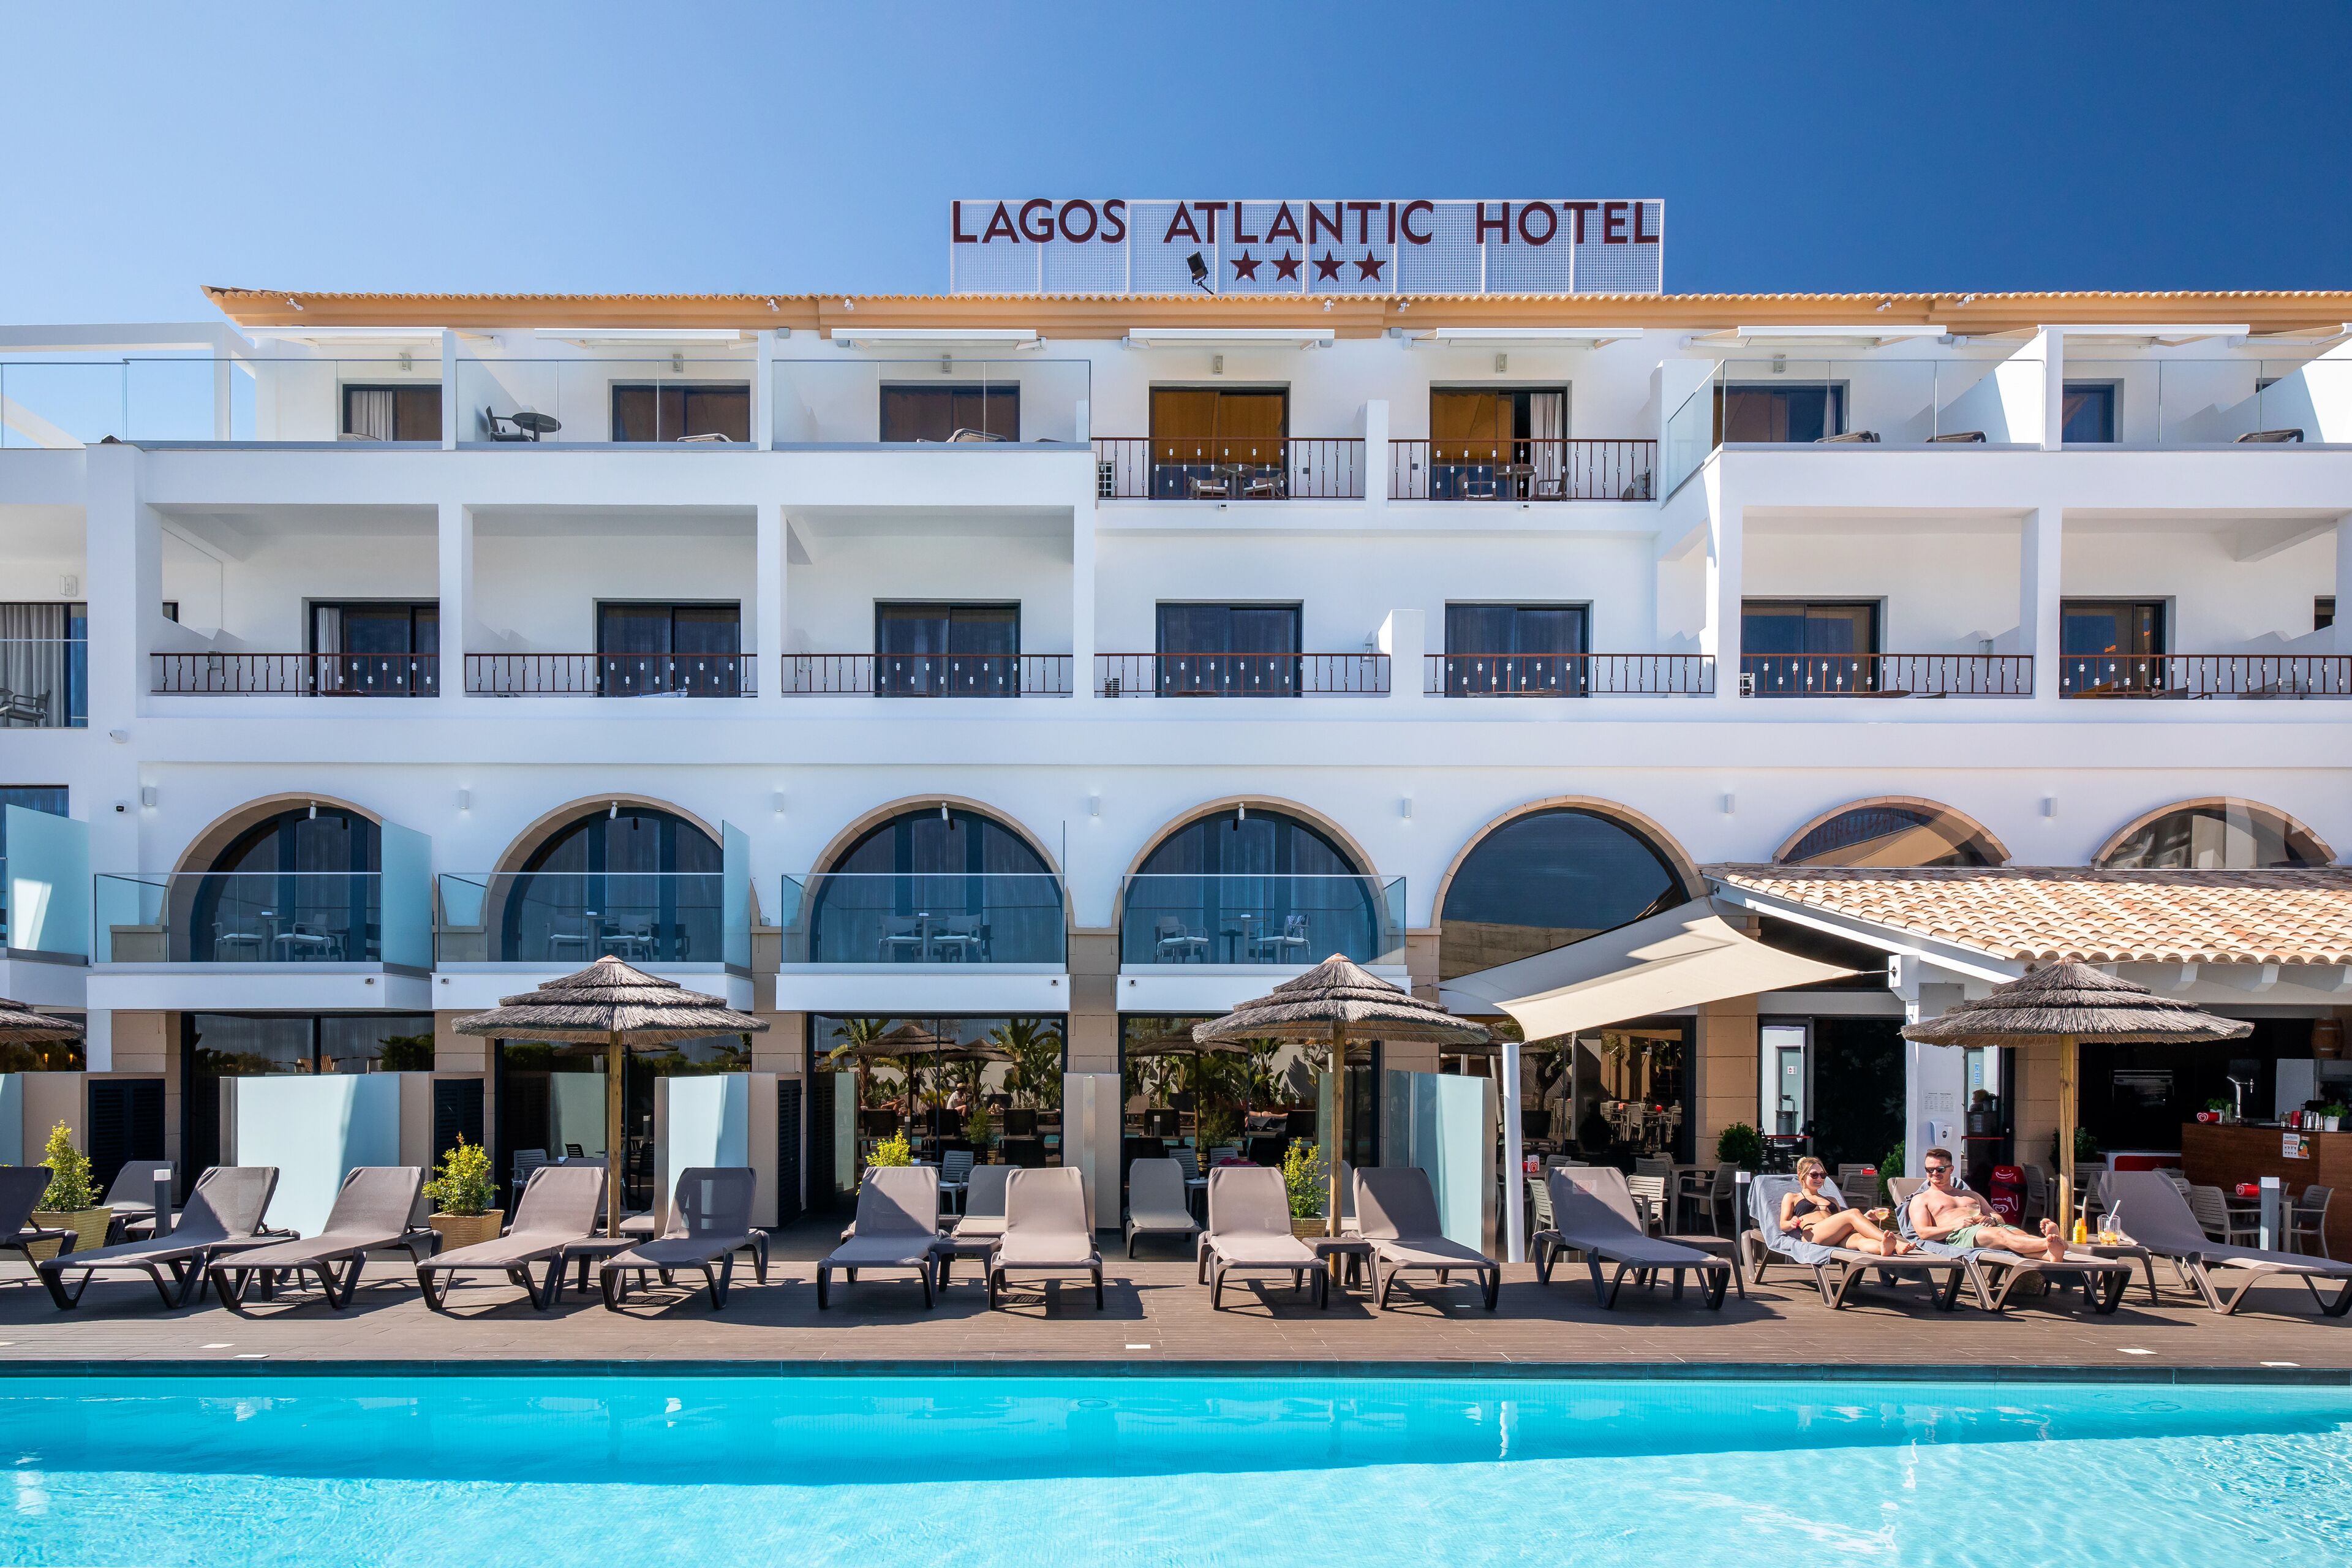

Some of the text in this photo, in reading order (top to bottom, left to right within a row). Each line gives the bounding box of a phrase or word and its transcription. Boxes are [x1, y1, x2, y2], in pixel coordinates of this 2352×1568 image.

[953, 198, 1659, 245] LAGOS ATLANTIC HOTEL
